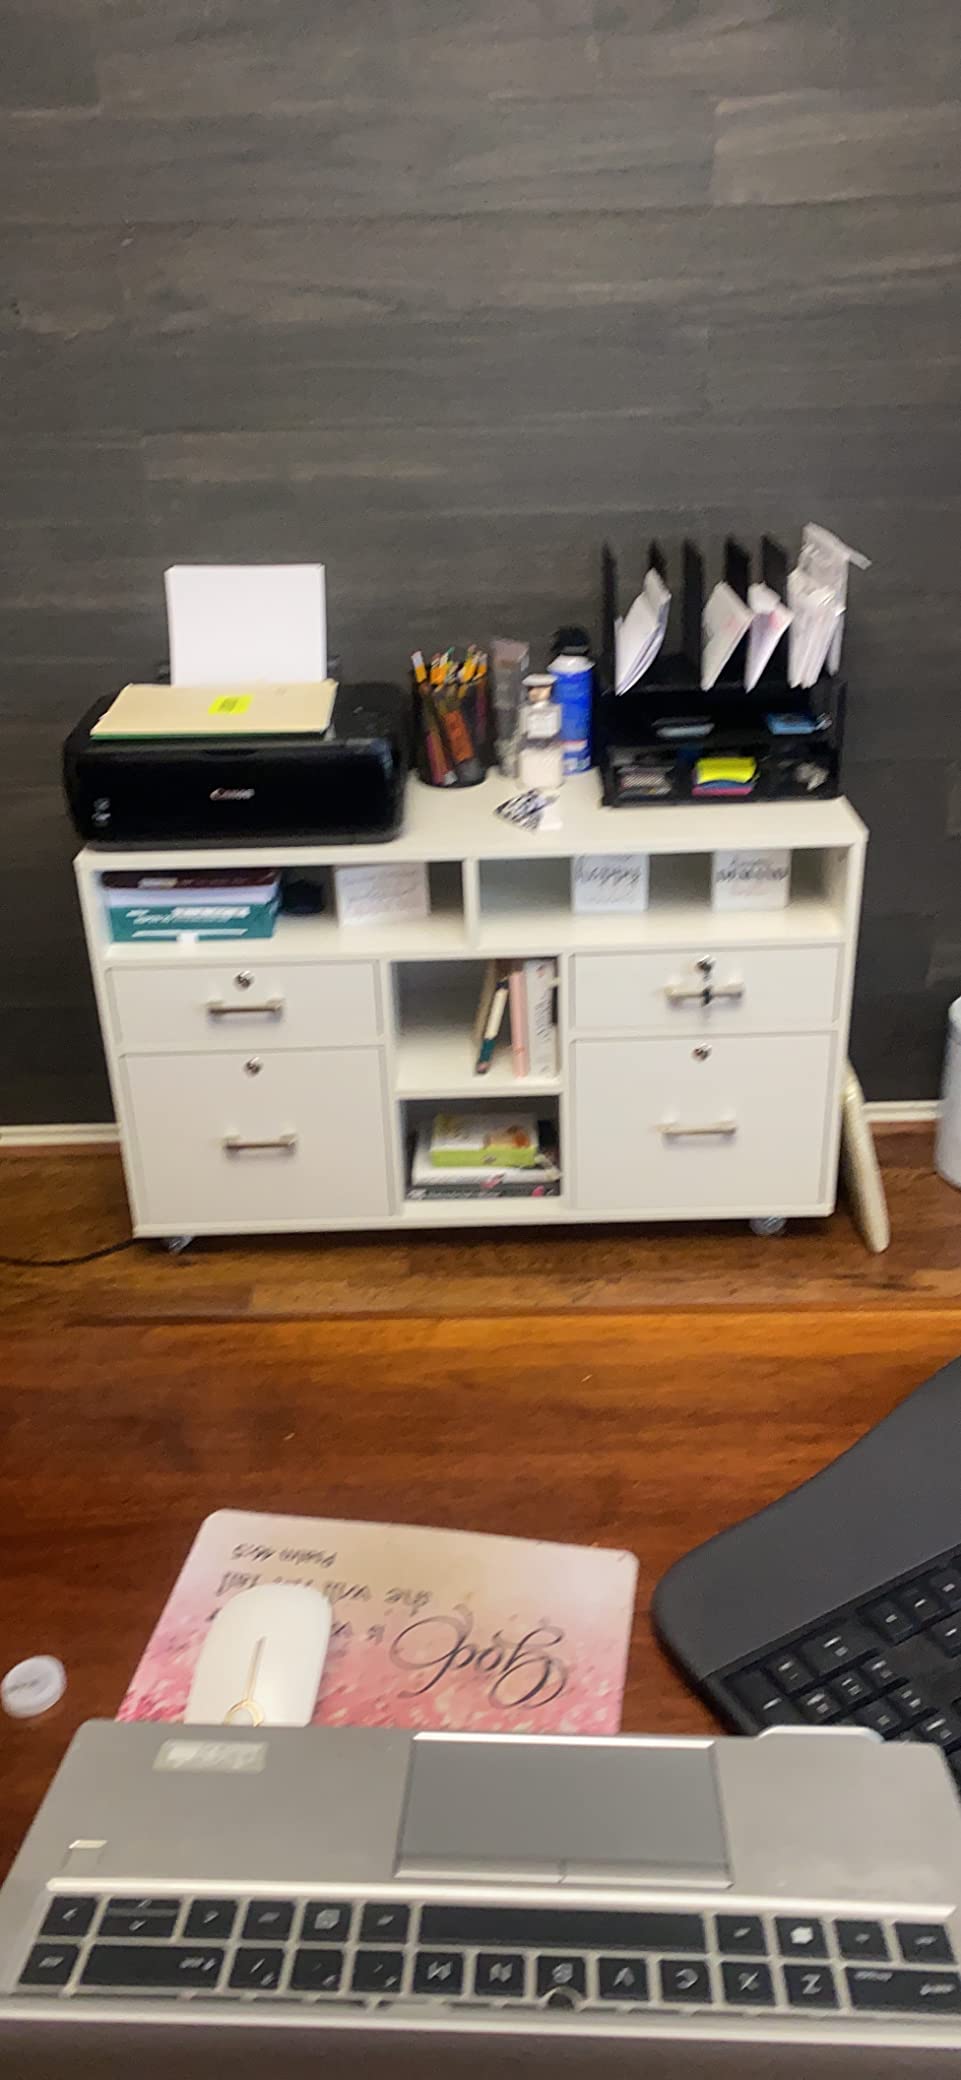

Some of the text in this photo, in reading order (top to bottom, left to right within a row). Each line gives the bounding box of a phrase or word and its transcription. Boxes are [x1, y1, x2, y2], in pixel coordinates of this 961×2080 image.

[209, 787, 256, 801] Canon
[278, 1550, 337, 1569] Psalm
[384, 1588, 432, 1617] she
[389, 1605, 569, 1710] God
[802, 1973, 822, 1995] Z
